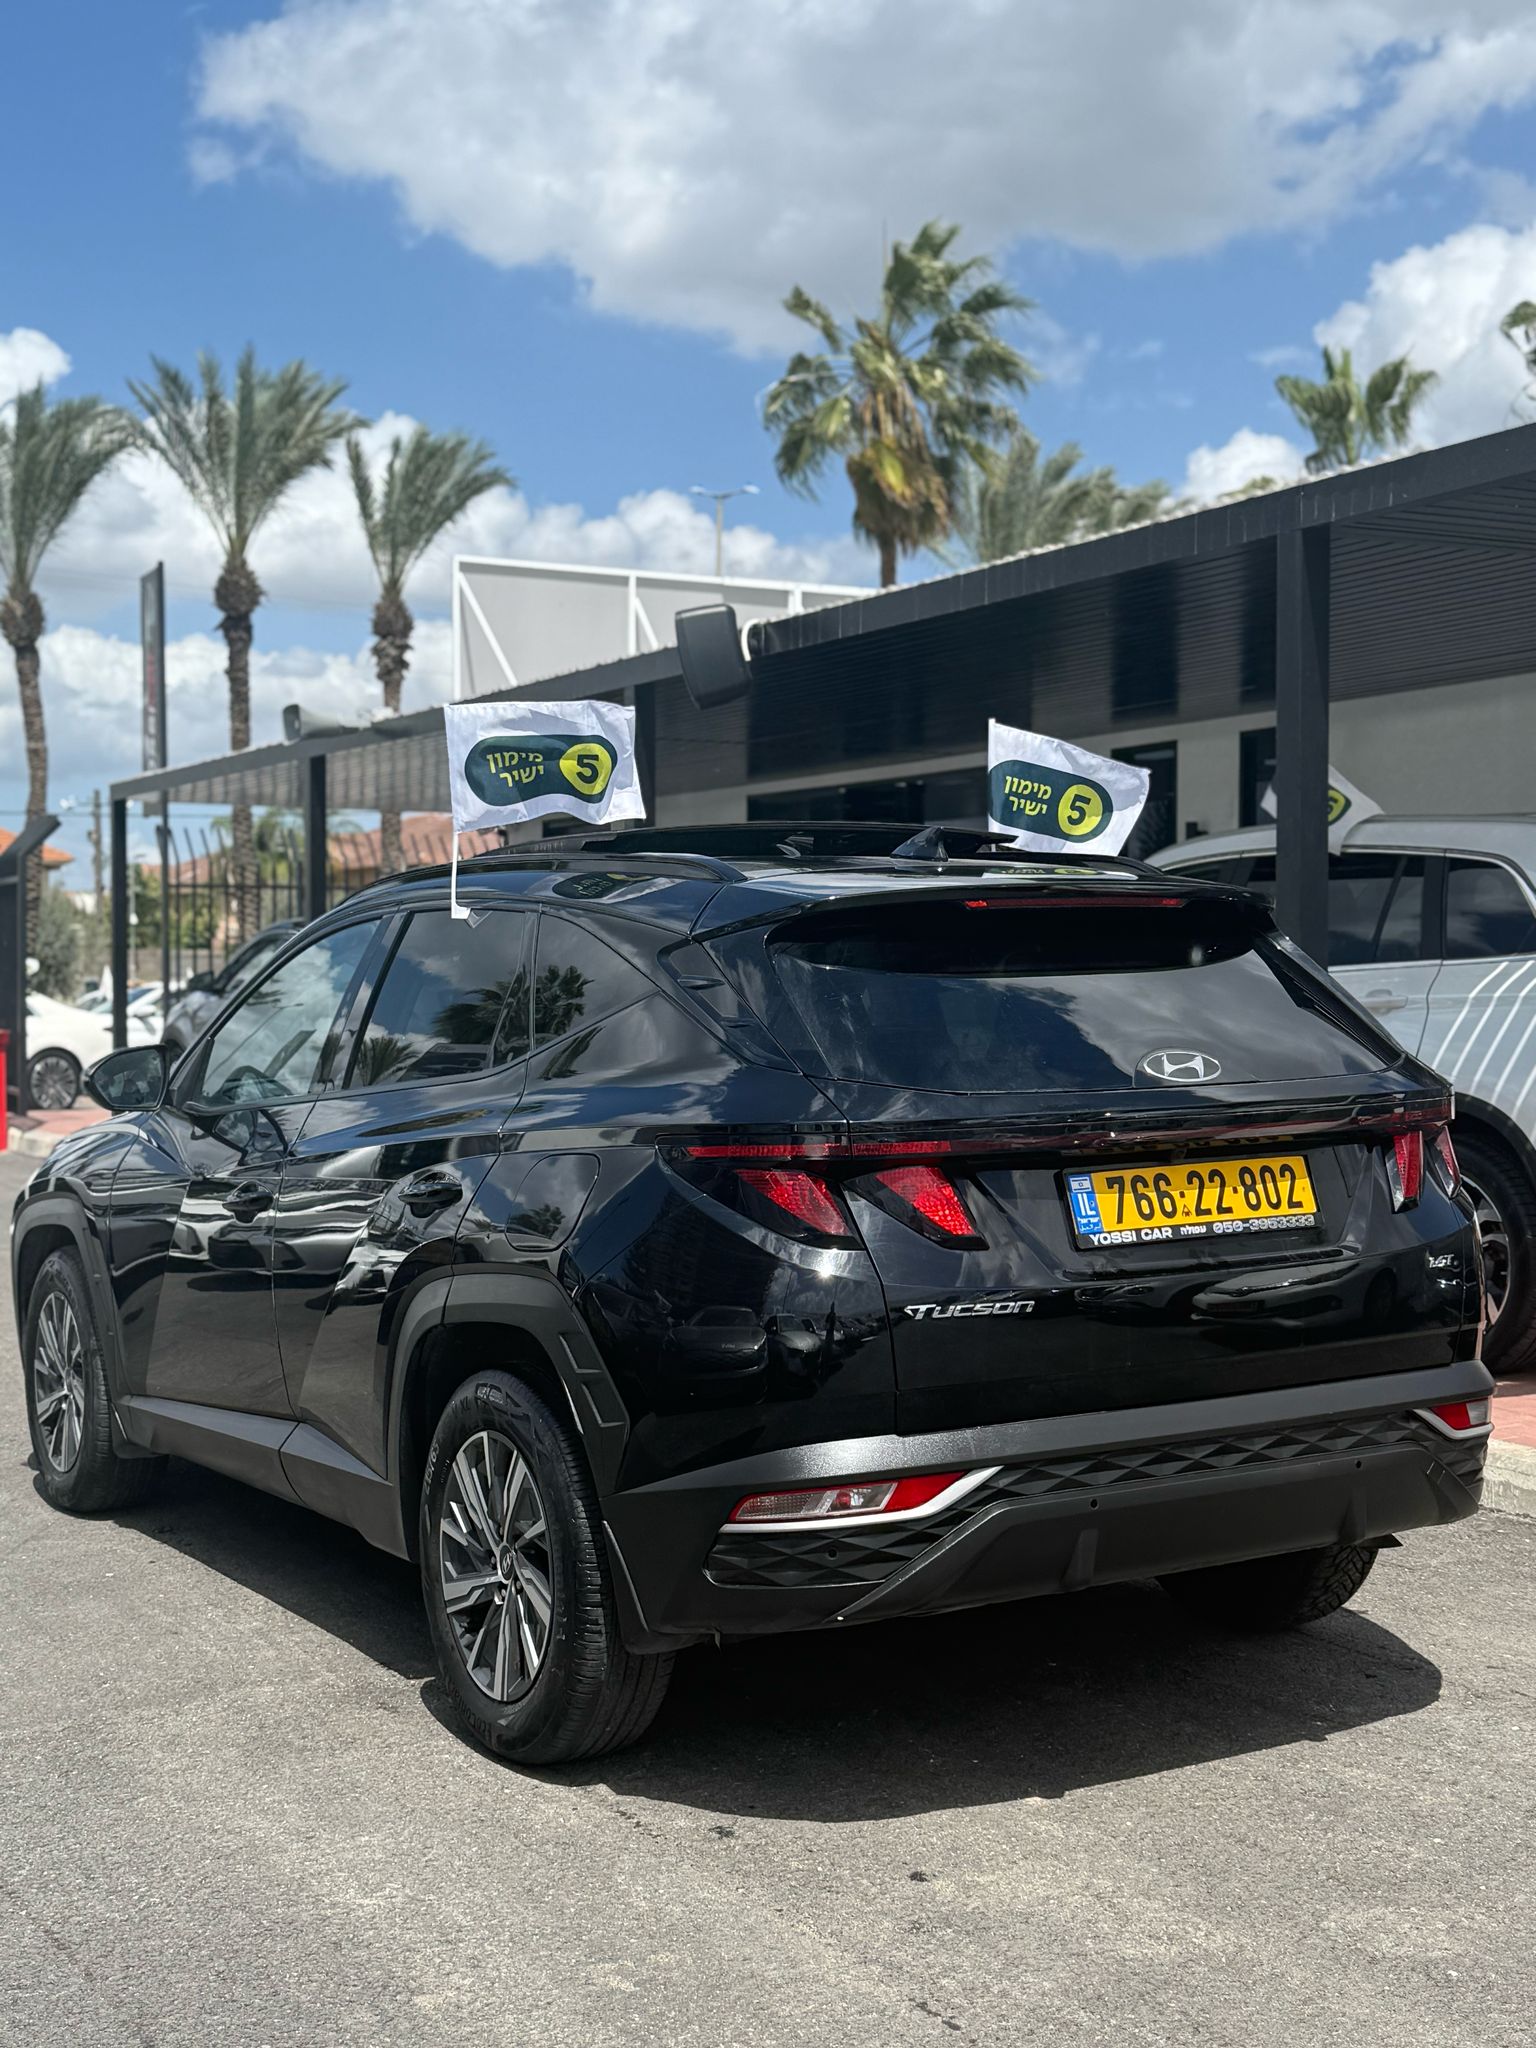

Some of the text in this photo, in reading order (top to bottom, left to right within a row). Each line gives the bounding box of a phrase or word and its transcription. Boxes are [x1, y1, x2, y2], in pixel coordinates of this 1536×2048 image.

[486, 751, 544, 774] מימון
[576, 754, 600, 785] 5
[498, 764, 545, 788] ישיר
[1003, 775, 1052, 800] מימון
[1008, 795, 1048, 816] ישיר
[1066, 793, 1092, 826] 5
[1077, 1193, 1097, 1216] IL
[1089, 1230, 1137, 1246] YOSSI
[1140, 1226, 1173, 1241] CAR
